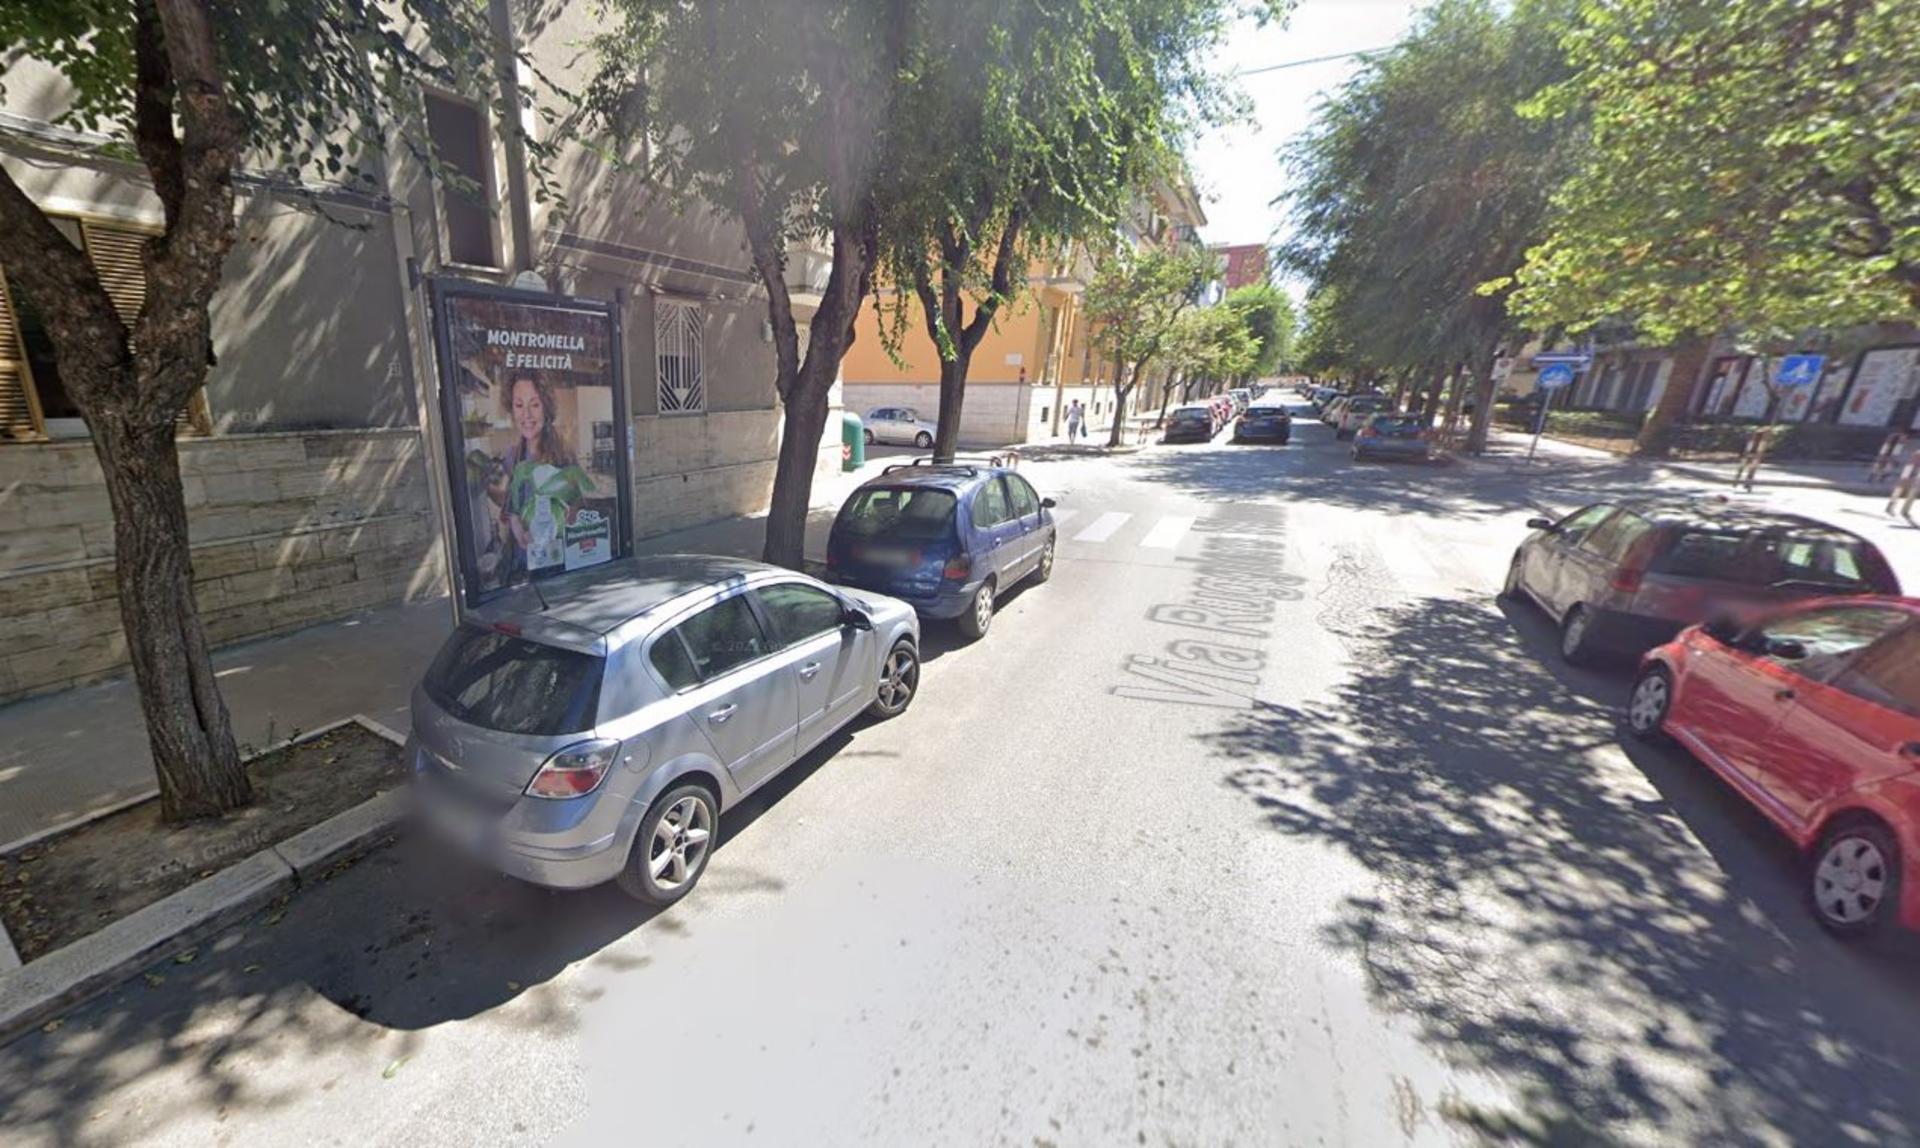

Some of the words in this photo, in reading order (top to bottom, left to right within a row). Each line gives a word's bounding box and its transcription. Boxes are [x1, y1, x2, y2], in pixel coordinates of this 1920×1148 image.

[487, 329, 585, 351] MONTRONELLA
[506, 350, 515, 367] È
[517, 352, 573, 370] FELICITÀ
